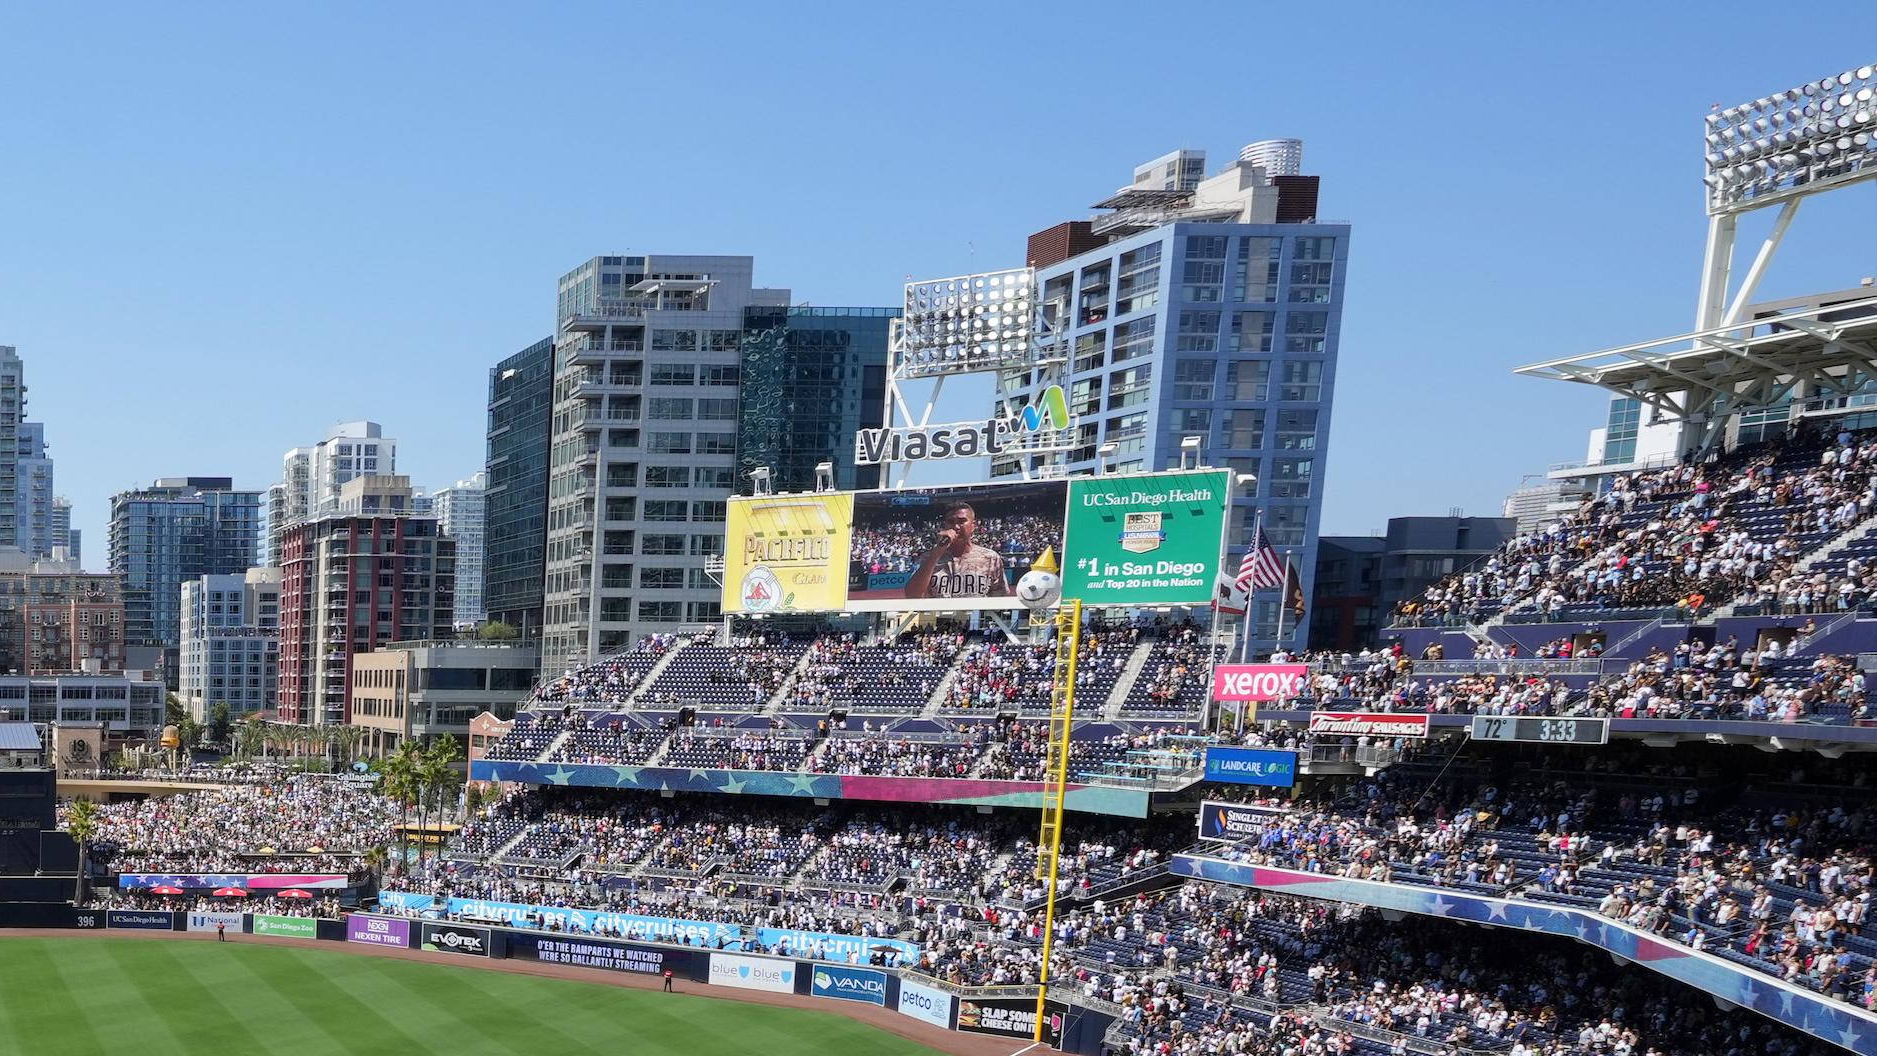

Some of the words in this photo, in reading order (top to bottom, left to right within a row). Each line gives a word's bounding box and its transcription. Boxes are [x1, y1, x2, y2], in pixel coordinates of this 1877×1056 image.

[861, 419, 1003, 462] Viasat
[1083, 494, 1103, 506] UC
[1105, 492, 1129, 505] San
[1131, 491, 1168, 506] Diego
[1169, 489, 1211, 502] Health
[1128, 514, 1159, 524] BEST
[1077, 558, 1100, 577] #1
[1104, 563, 1119, 576] in
[1122, 562, 1154, 576] San
[1156, 561, 1205, 577] Diego
[1087, 580, 1105, 589] and
[1106, 580, 1126, 590] Top
[1126, 579, 1141, 588] 20
[1141, 579, 1152, 588] in
[1152, 578, 1169, 587] the
[1170, 577, 1204, 588] Nation
[1222, 672, 1296, 696] xerox
[1311, 714, 1374, 733] Tarantino
[1372, 721, 1425, 735] SAUSAGES
[1484, 719, 1508, 739] 72°
[1539, 719, 1577, 742] 3:33
[1220, 759, 1262, 773] LANDCARE
[336, 773, 381, 782] Gallagher
[343, 780, 374, 790] Square
[78, 916, 95, 928] 396
[134, 917, 149, 925] Diego
[269, 922, 282, 930] San
[282, 923, 299, 932] Diego
[595, 912, 711, 940] citycruises
[354, 931, 381, 942] NEXEN
[383, 934, 401, 944] TIRE
[537, 940, 555, 950] O'ER
[555, 942, 570, 951] THE
[571, 943, 611, 958] RAMPARTS
[613, 948, 625, 959] WE
[626, 949, 664, 964] WATCHED
[539, 951, 560, 962] WERE
[560, 952, 571, 963] SO
[571, 953, 615, 968] GALLANTLY
[615, 958, 661, 974] STREAMING
[712, 963, 738, 975] blue
[754, 967, 780, 980] blue
[833, 976, 884, 993] VANDA
[902, 988, 932, 1010] petco
[981, 1006, 1008, 1020] SLAP
[1008, 1010, 1037, 1024] SOME
[980, 1018, 1013, 1031] CHEESE
[1012, 1021, 1027, 1033] ON
